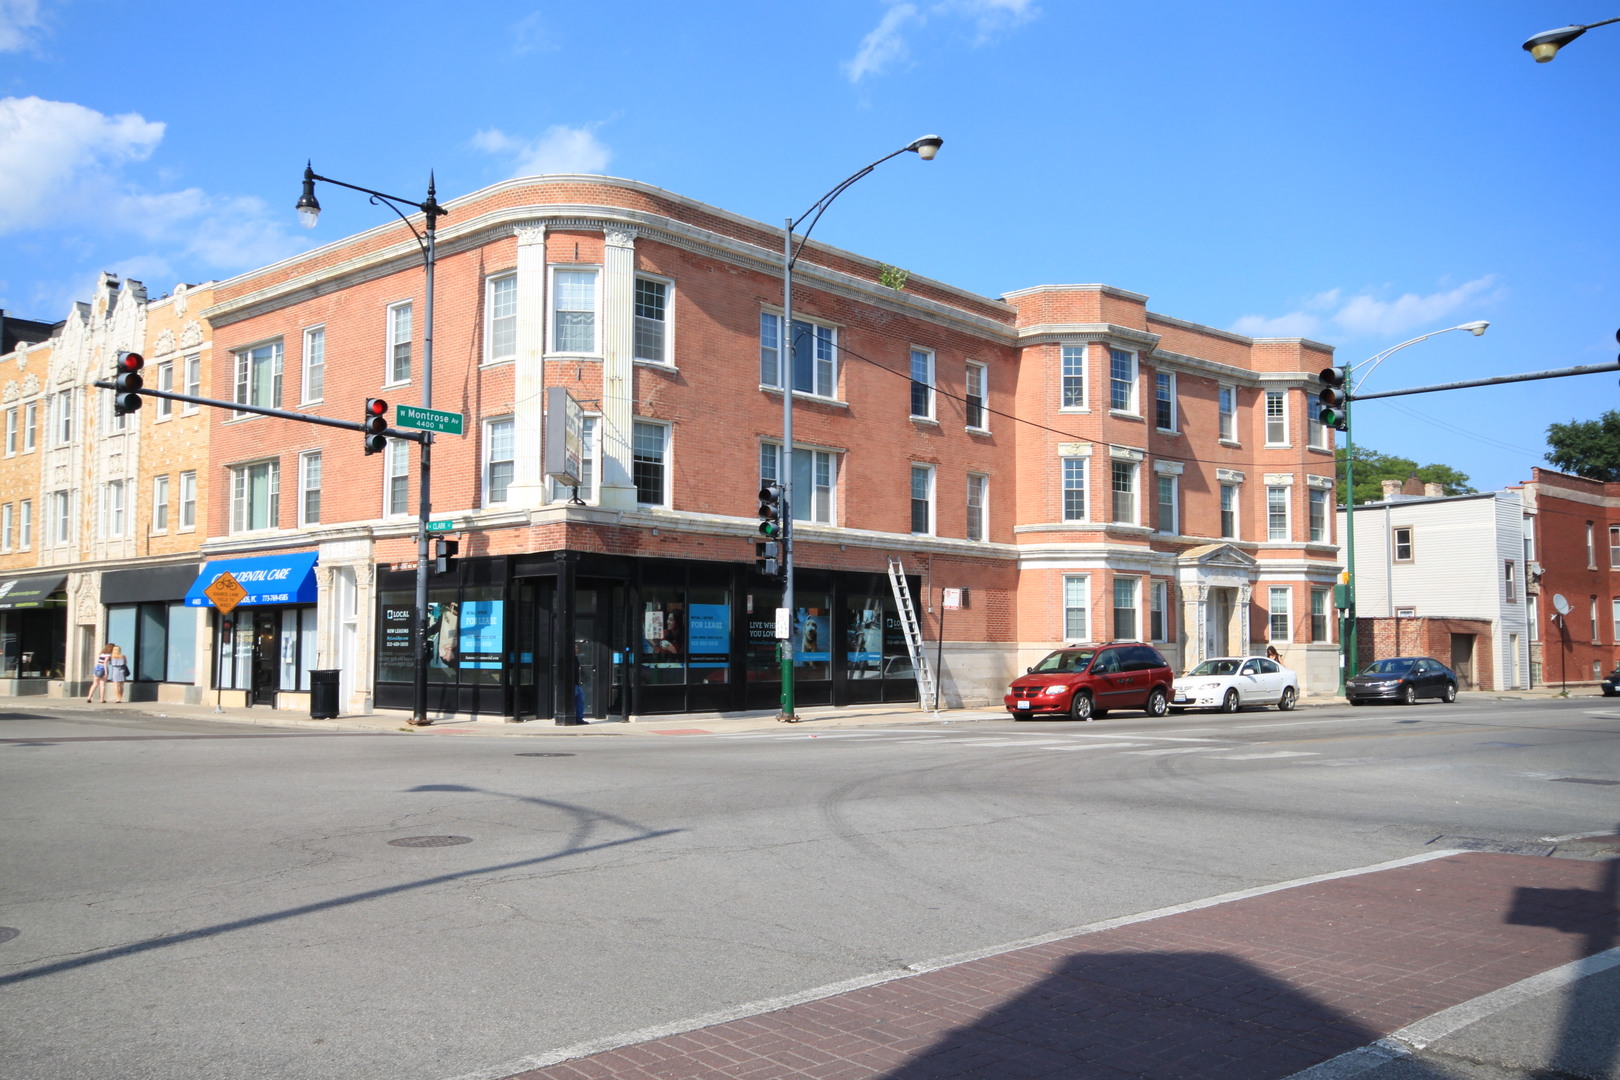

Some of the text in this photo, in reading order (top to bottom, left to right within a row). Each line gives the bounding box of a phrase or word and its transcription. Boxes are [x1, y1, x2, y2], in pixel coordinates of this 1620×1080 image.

[408, 409, 450, 423] Montrose
[238, 570, 268, 582] DENTAL
[267, 568, 292, 580] CARE
[466, 617, 497, 625] FOR LEASE
